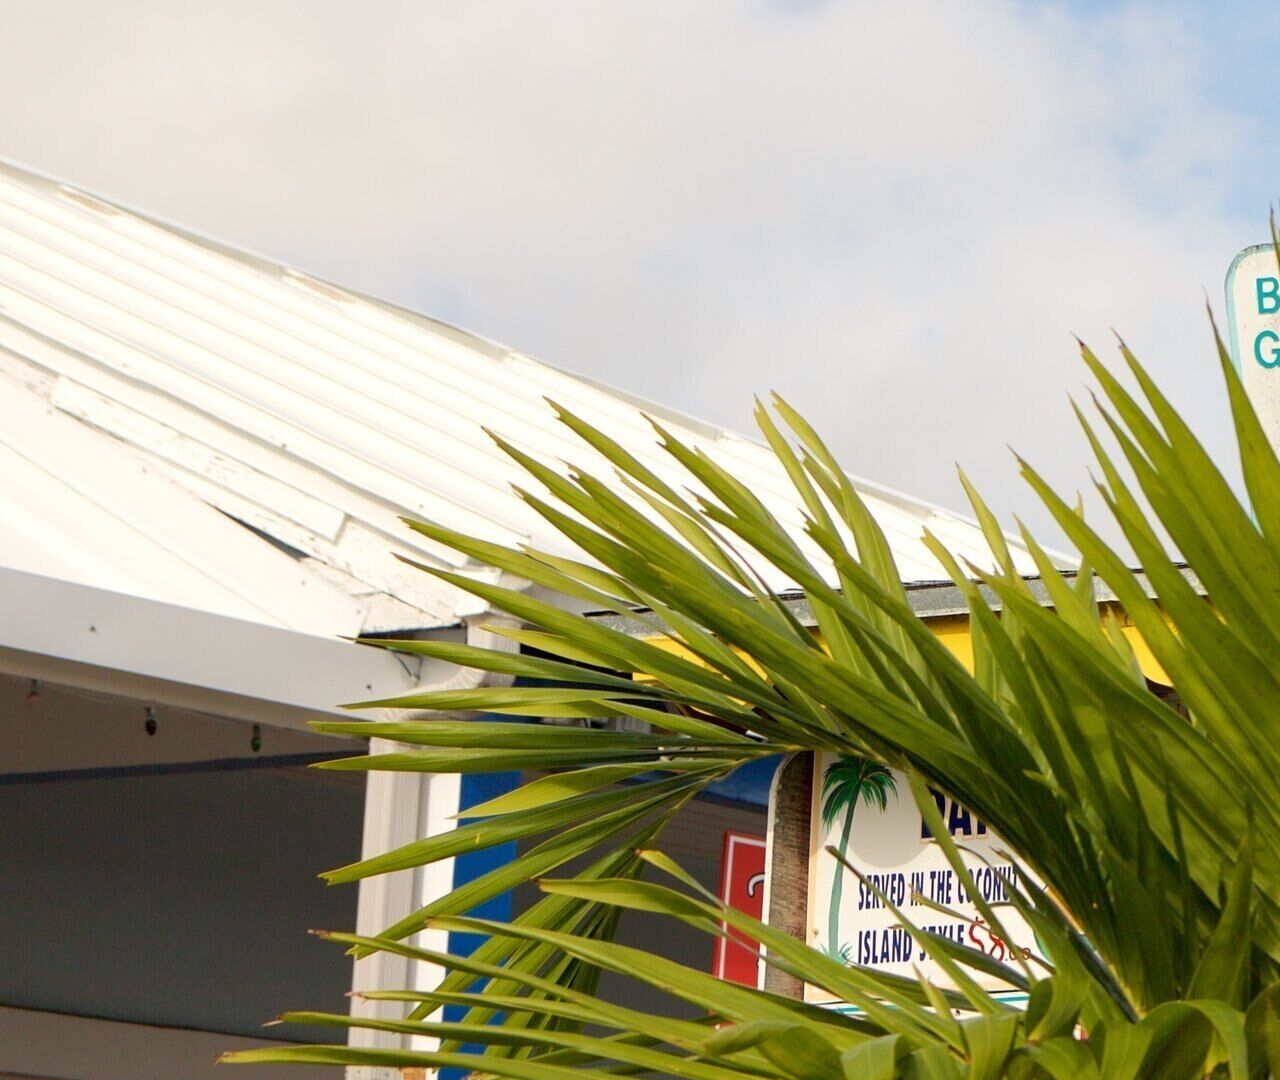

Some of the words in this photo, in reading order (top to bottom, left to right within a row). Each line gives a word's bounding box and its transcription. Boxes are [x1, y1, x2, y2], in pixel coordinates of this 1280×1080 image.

[859, 873, 905, 910] SERVED
[930, 870, 952, 905] THE
[858, 928, 912, 965] ISLAND
